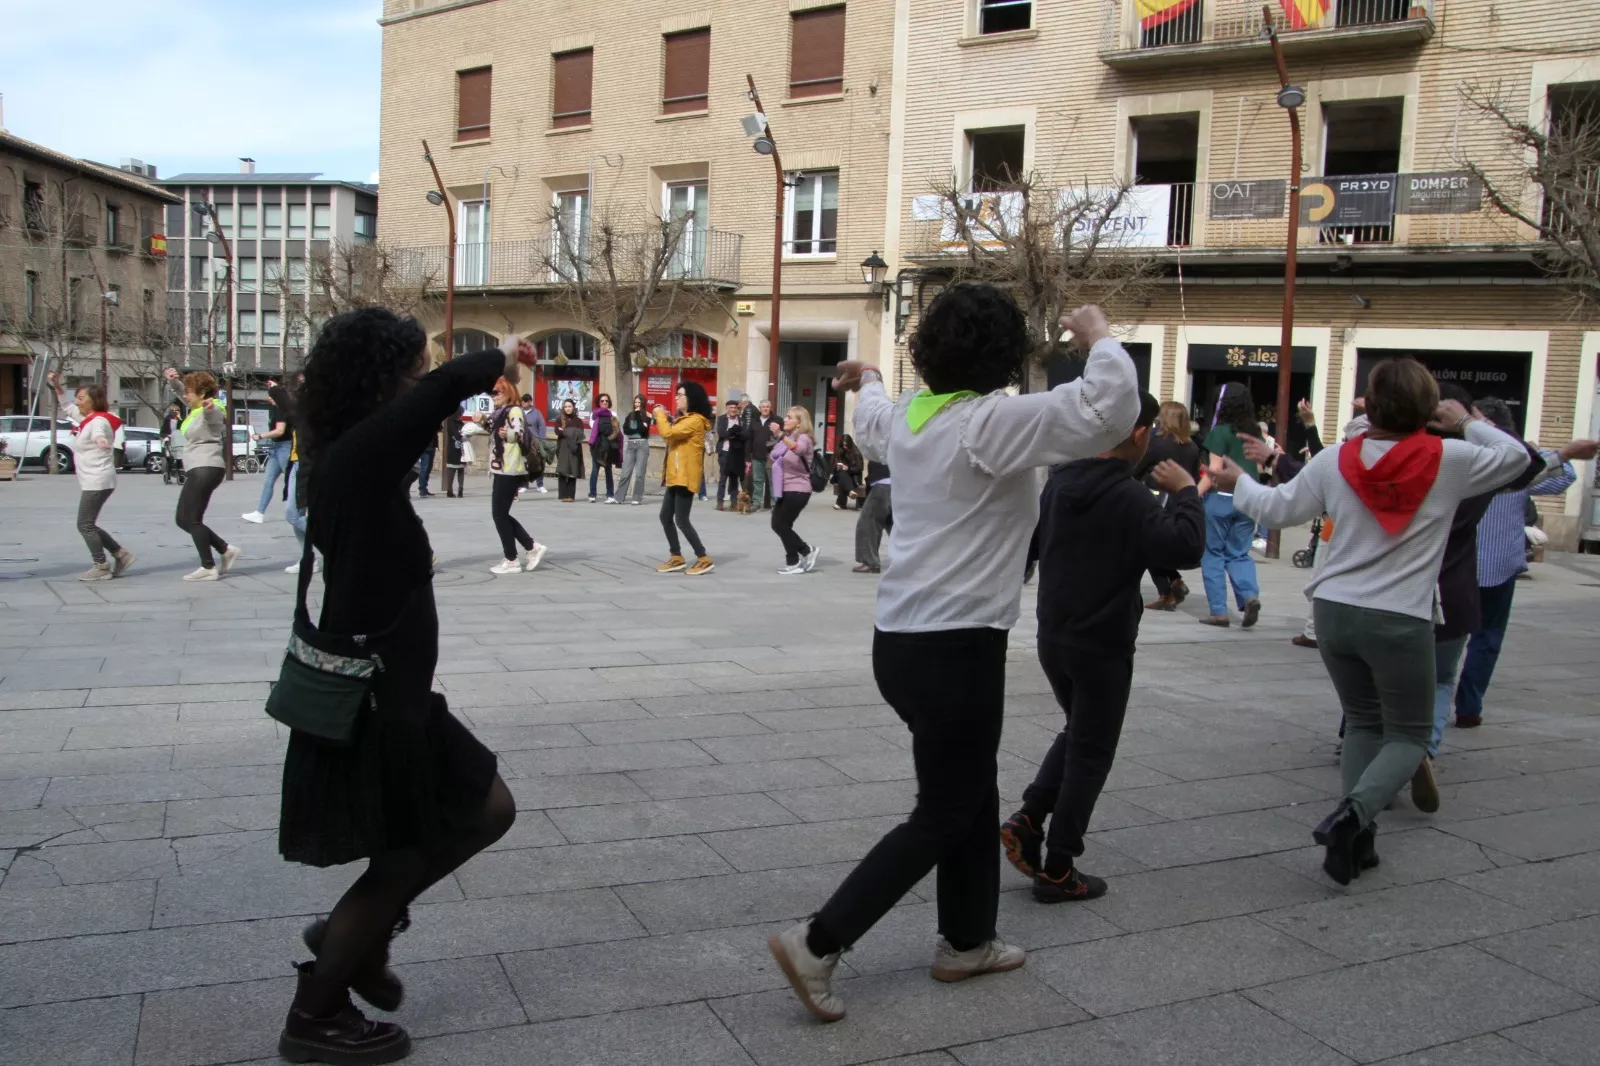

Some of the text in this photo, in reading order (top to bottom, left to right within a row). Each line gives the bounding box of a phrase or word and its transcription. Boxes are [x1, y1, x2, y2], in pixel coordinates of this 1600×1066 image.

[1213, 182, 1257, 199] OAT
[1410, 177, 1469, 190] DOMPER
[1410, 190, 1468, 199] ARQUITECTURA
[1249, 348, 1279, 362] alea
[1432, 368, 1508, 383] ALÓN DE JUEGO
